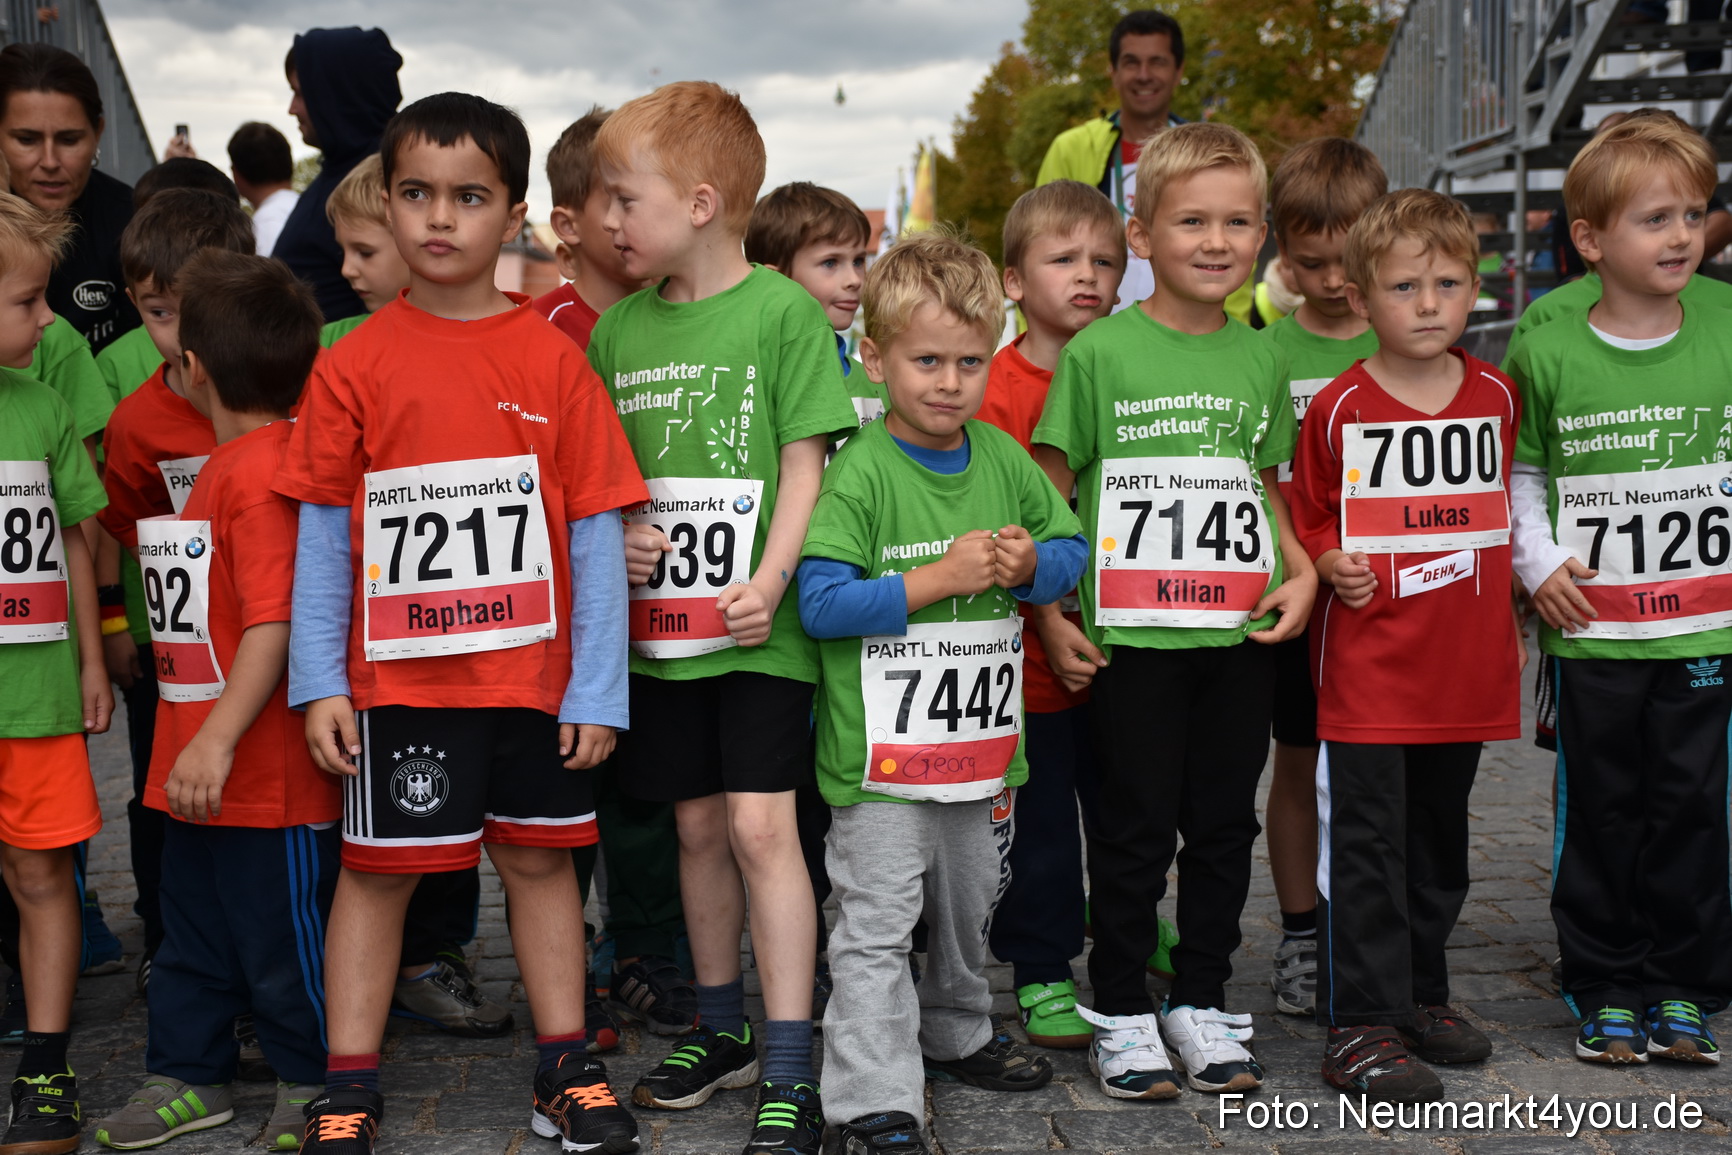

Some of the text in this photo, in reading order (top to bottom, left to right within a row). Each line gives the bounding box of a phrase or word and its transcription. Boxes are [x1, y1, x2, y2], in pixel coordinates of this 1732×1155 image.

[498, 401, 510, 411] FC
[1114, 392, 1233, 418] Neumarkter
[1115, 416, 1210, 443] Stadtlauf
[1557, 405, 1686, 433] Neumarkter
[1363, 421, 1498, 488] 7000
[1561, 429, 1660, 457] Stadtlauf
[368, 477, 513, 508] PARTL Neumarkt
[1106, 474, 1248, 492] PARTL Neumarkt
[1350, 486, 1356, 496] 2
[650, 497, 725, 514] Neumarkt
[1564, 484, 1714, 508] PARTL Neumarkt
[1404, 504, 1470, 529] Lukas
[1119, 499, 1261, 563] 7143
[1576, 506, 1731, 575] 7126
[381, 504, 529, 585] 7217
[537, 564, 544, 577] K
[1104, 556, 1111, 568] 2
[1422, 562, 1457, 584] DEHN
[371, 583, 378, 595] 2
[1157, 578, 1226, 604] Kilian
[0, 592, 30, 619] as
[408, 594, 514, 634] Raphael
[1633, 592, 1681, 616] Tim
[650, 608, 689, 633] Finn
[867, 638, 1008, 659] PARTL Neumarkt
[1690, 676, 1724, 688] adidas
[885, 662, 1015, 735] 7442
[397, 763, 442, 781] DEUTSCHLAND
[902, 748, 976, 782] Georg
[1093, 1015, 1116, 1025] LICO
[38, 1086, 63, 1097] LICO
[779, 1089, 806, 1101] LICO
